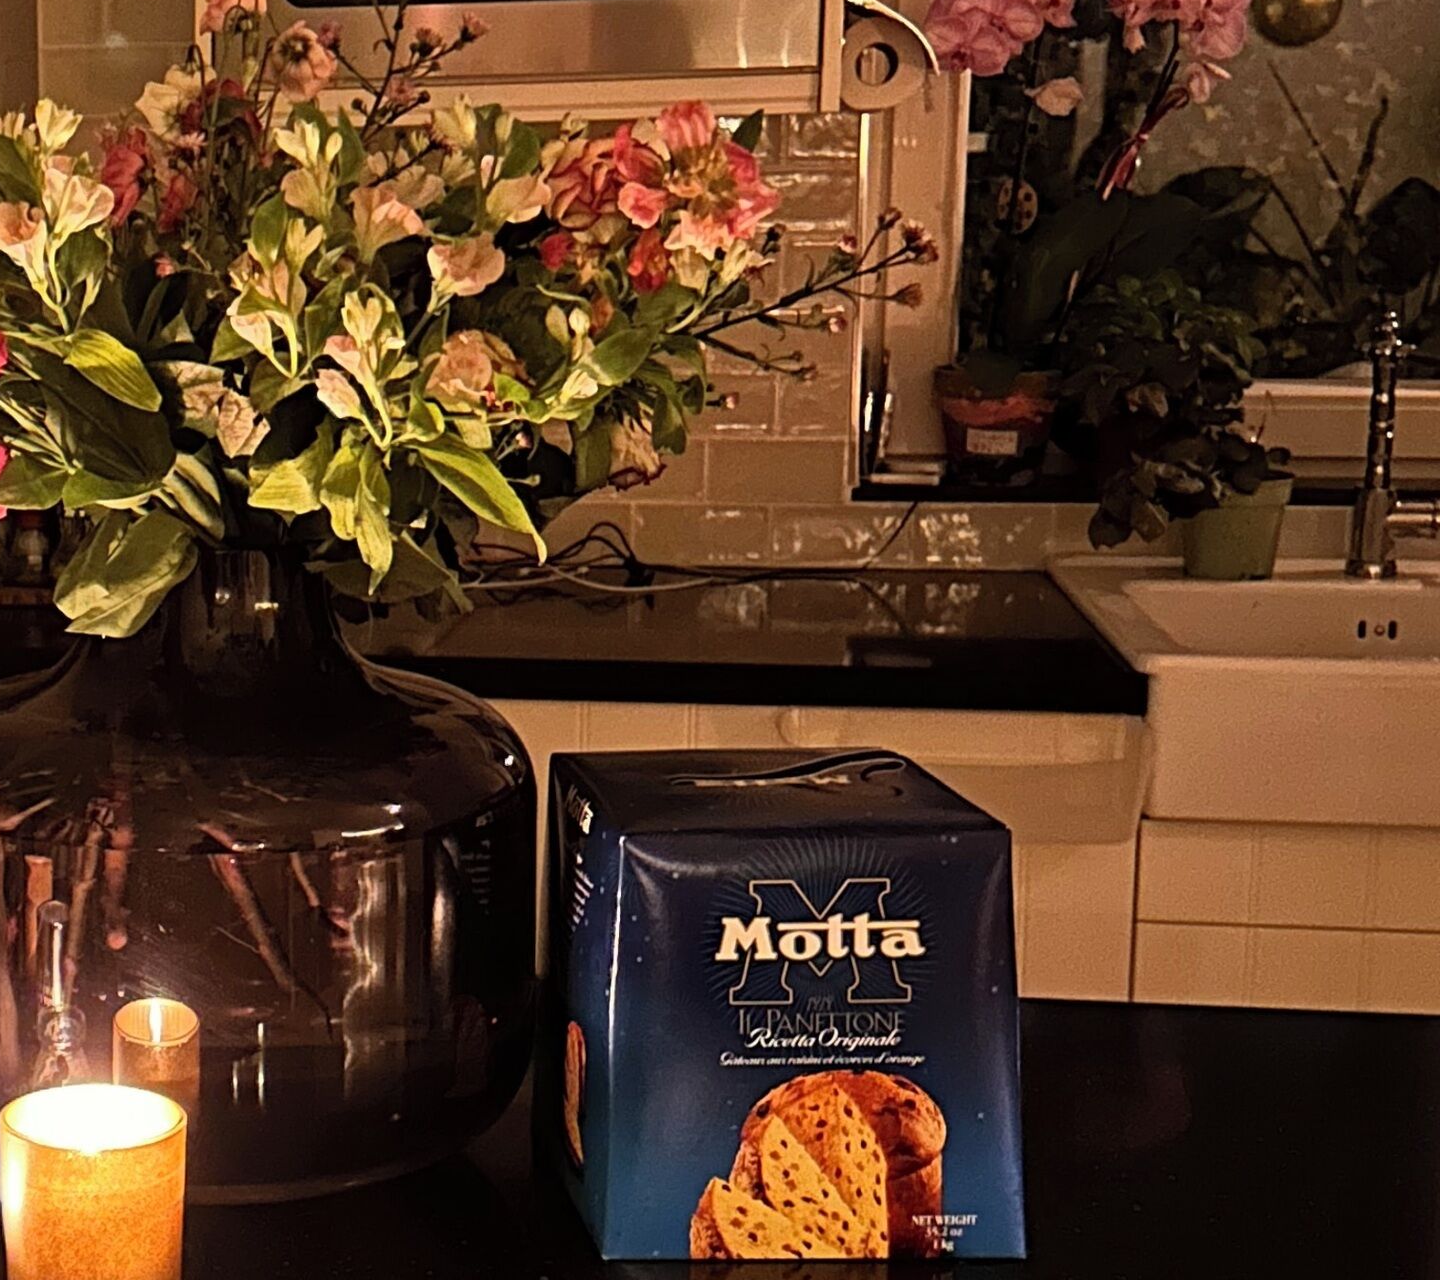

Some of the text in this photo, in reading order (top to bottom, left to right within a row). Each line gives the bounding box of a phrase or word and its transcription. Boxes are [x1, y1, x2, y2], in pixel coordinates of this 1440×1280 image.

[715, 913, 926, 961] Motta
[744, 1027, 902, 1051] Ricetta Originale
[911, 1214, 978, 1226] NET WEIGHT
